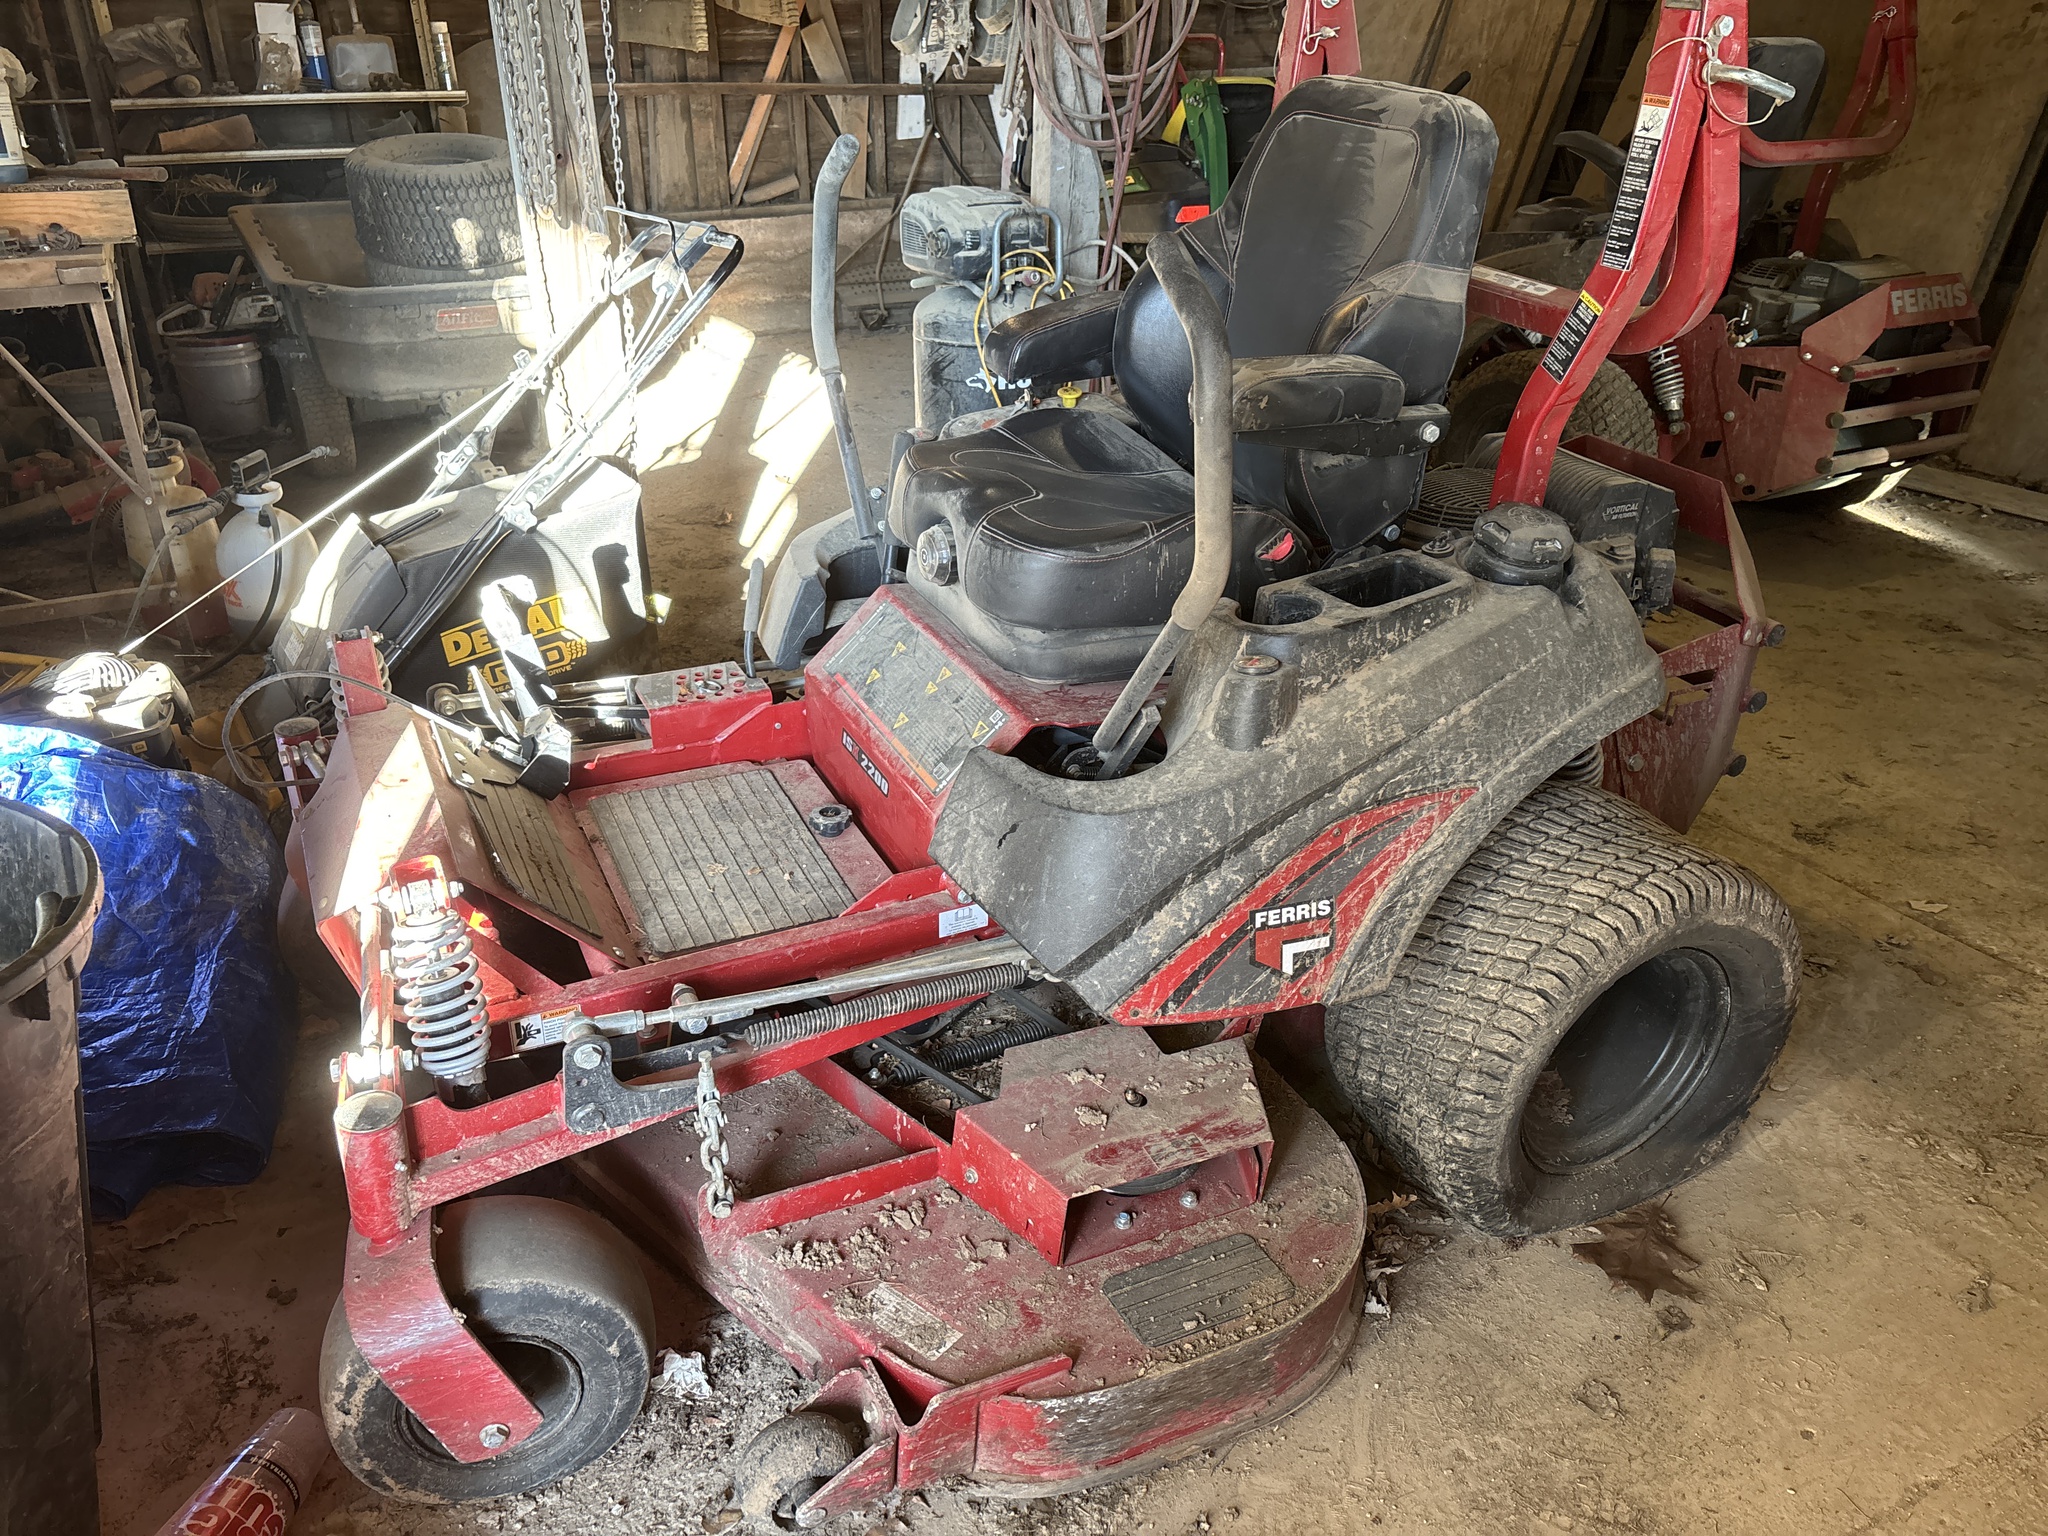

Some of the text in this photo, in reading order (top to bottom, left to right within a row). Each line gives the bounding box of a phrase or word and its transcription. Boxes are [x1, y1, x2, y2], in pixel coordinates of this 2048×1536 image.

[1584, 296, 1601, 314] CAUTION
[1890, 282, 1968, 316] FERRIS
[1606, 503, 1639, 514] VORTICAL
[860, 753, 889, 796] 2200
[1255, 899, 1331, 929] FERRIS
[270, 1464, 288, 1481] EXTRA
